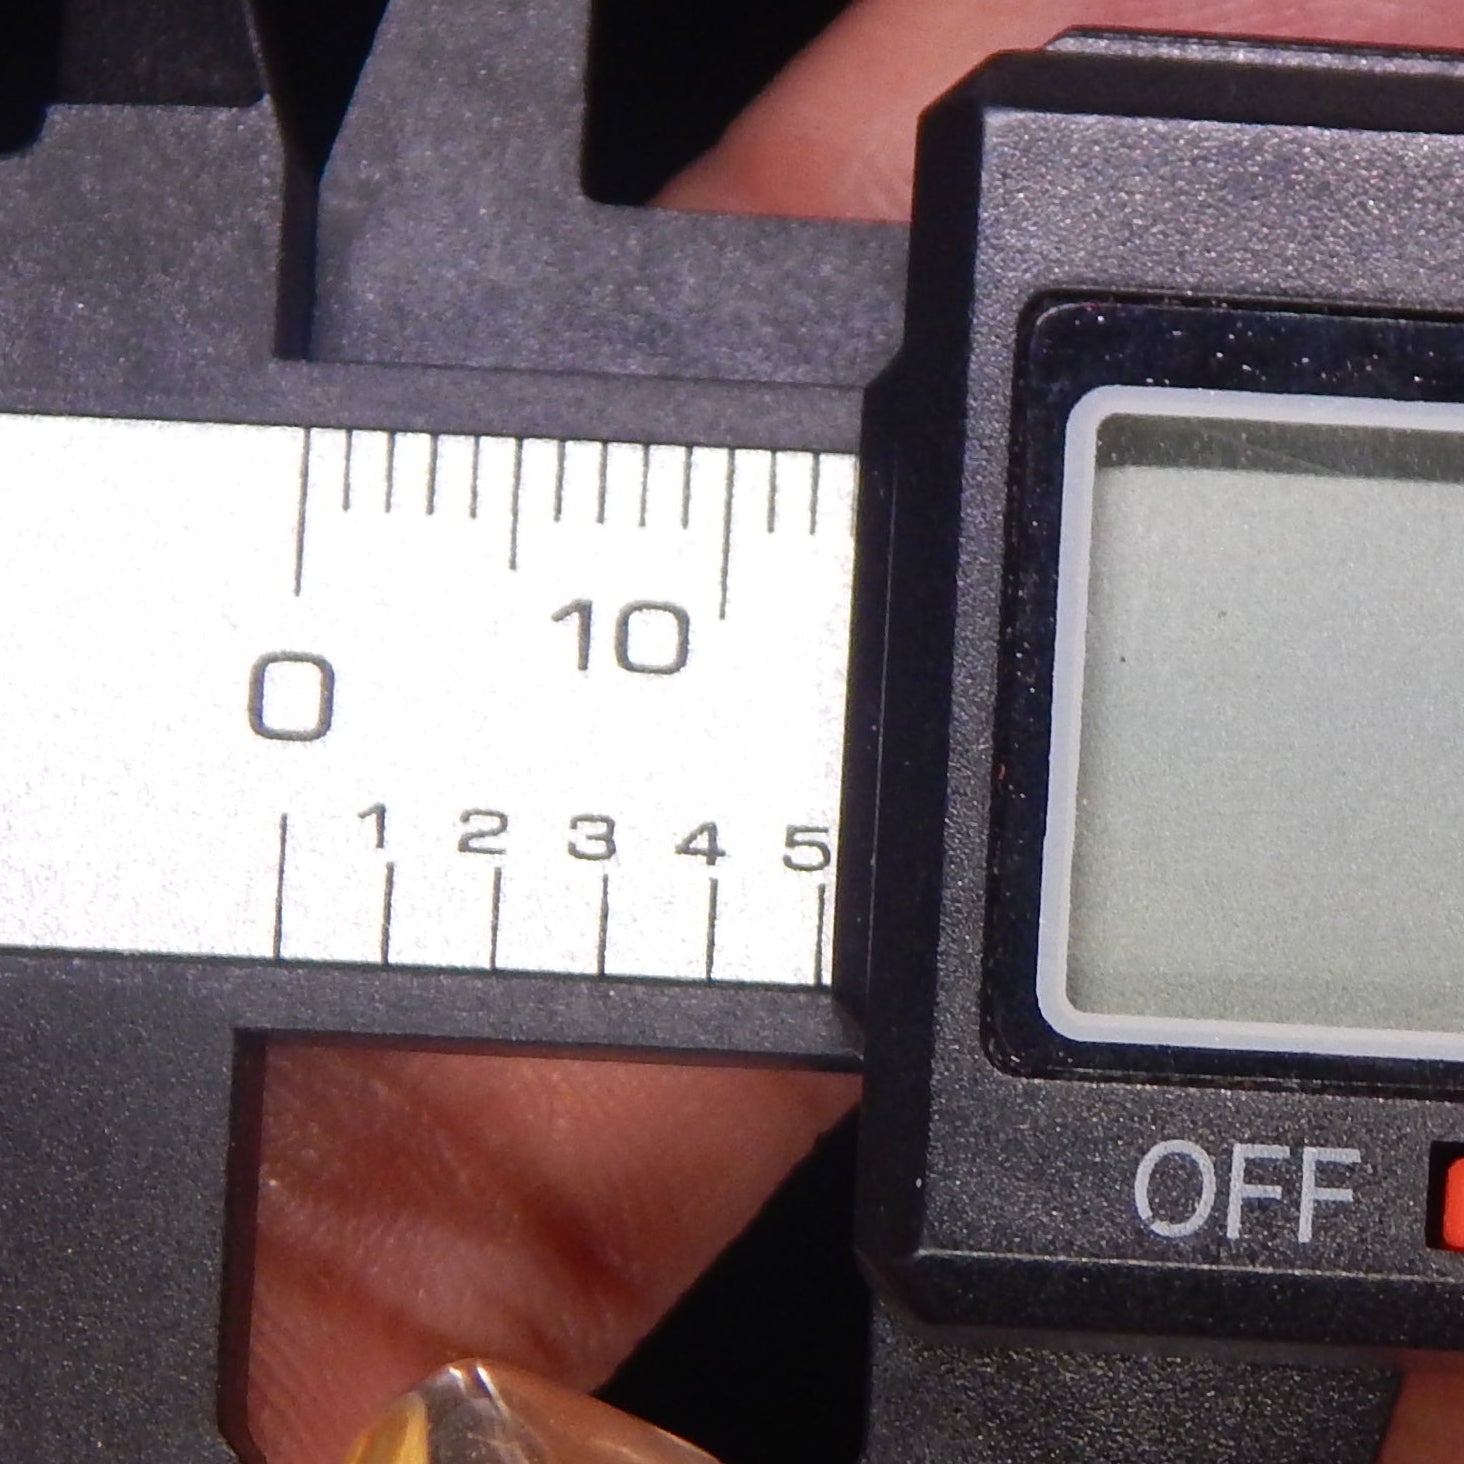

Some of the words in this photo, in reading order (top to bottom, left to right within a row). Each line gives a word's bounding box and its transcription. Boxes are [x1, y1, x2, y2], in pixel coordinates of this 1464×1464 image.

[550, 598, 690, 675] 10
[248, 649, 335, 742] 0
[356, 802, 388, 849] 1
[457, 808, 510, 855] 2
[566, 813, 618, 861] 3
[674, 821, 727, 866] 4
[782, 825, 833, 872] 5
[1132, 1137, 1363, 1247] OFF
